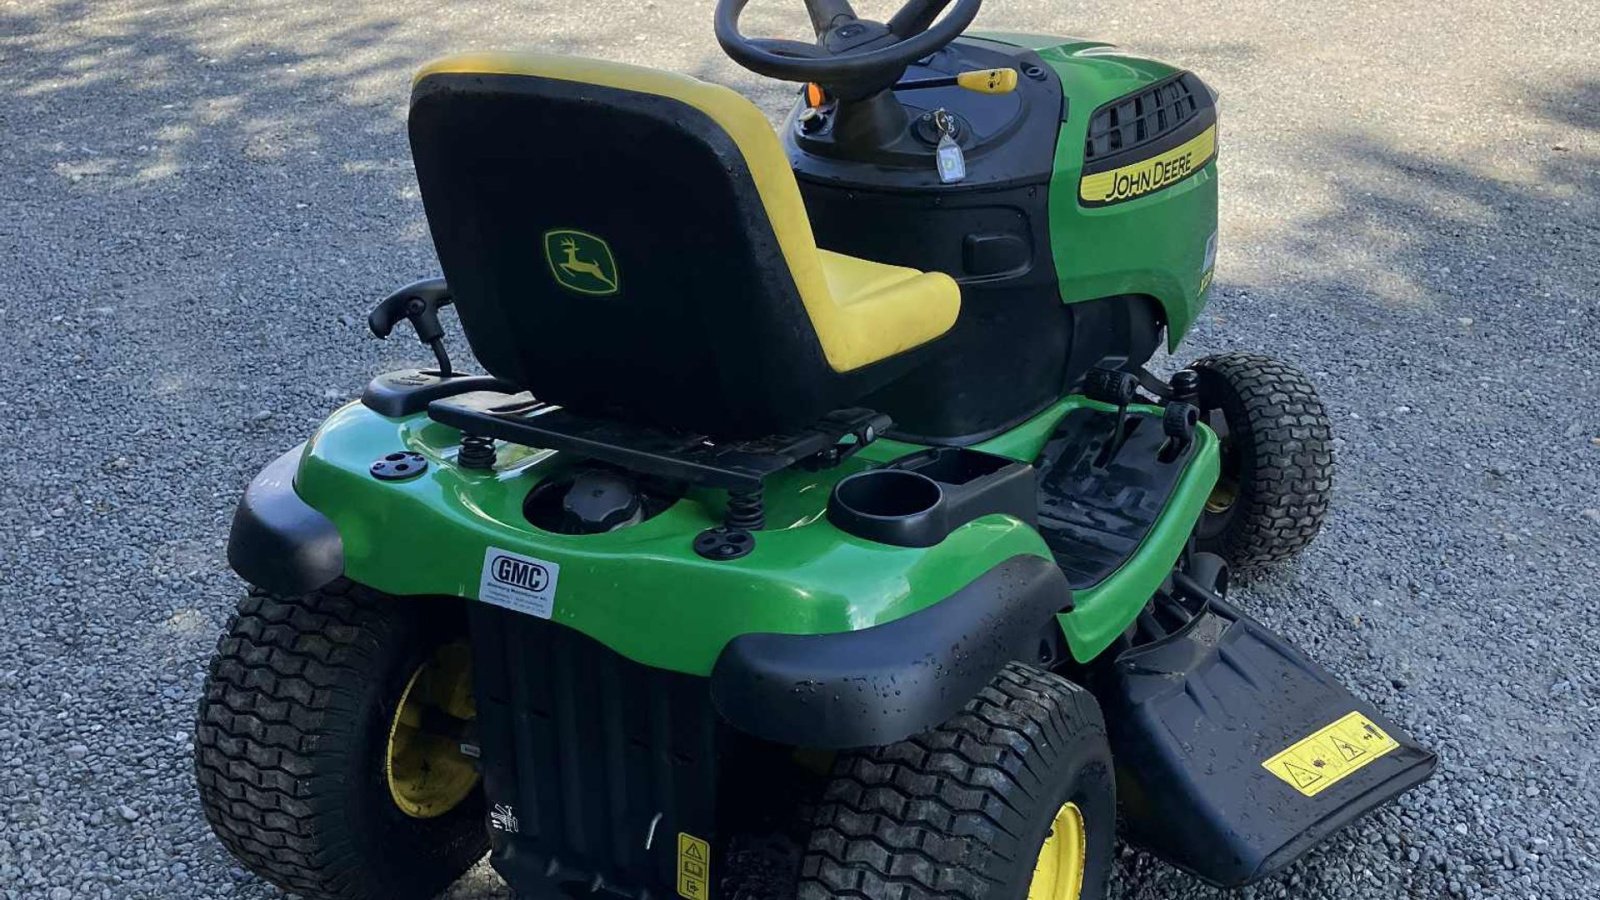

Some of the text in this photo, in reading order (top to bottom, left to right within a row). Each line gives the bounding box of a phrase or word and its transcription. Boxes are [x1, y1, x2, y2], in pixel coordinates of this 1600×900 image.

[1105, 152, 1192, 199] JOHN DEERE
[498, 559, 541, 588] GMC
